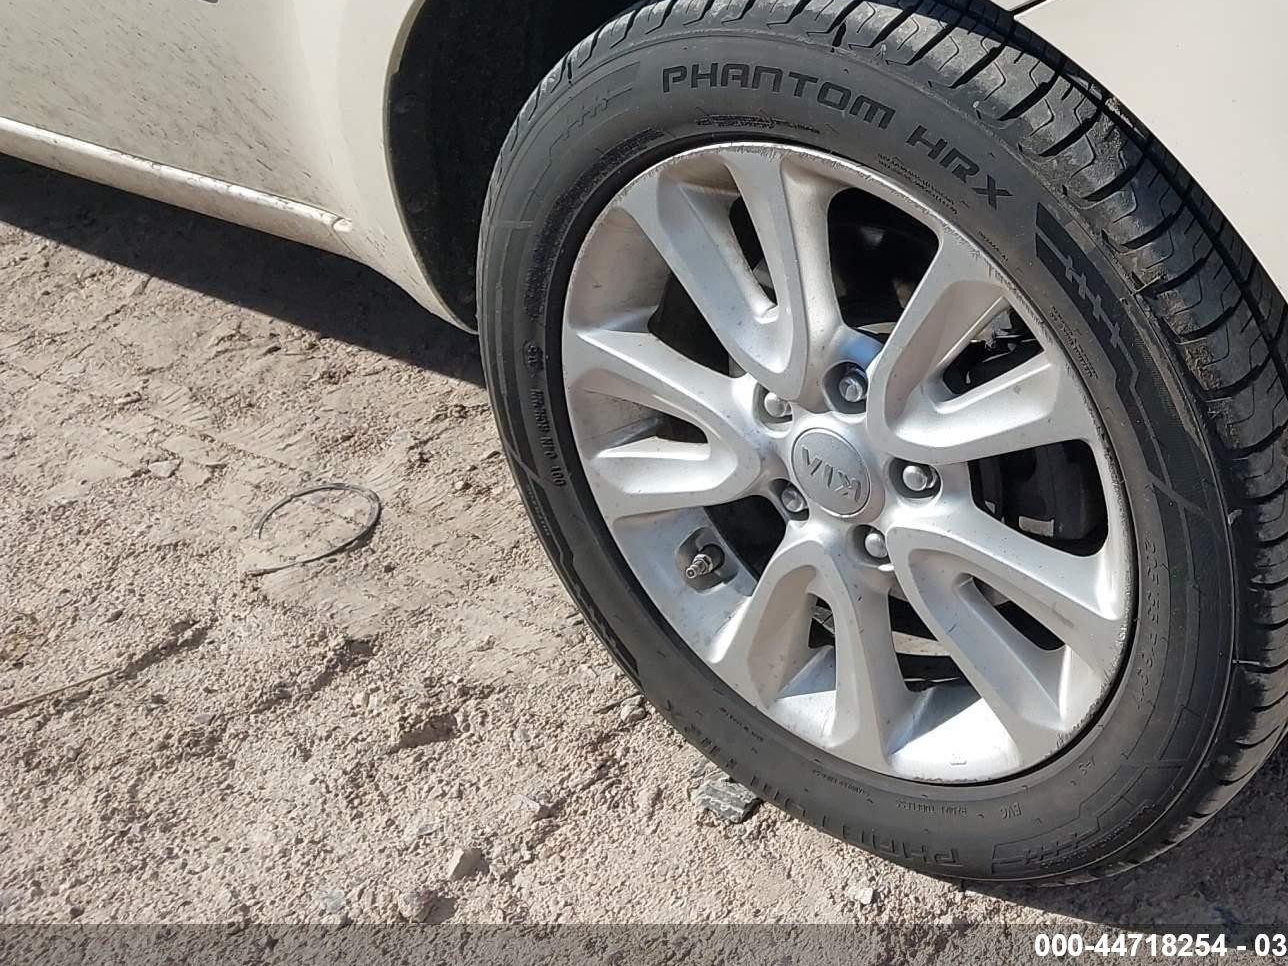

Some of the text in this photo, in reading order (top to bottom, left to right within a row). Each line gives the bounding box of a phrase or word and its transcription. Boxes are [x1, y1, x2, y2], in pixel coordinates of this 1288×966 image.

[661, 62, 897, 130] PHANTOM
[905, 124, 1014, 211] HRX
[801, 445, 862, 503] KIA
